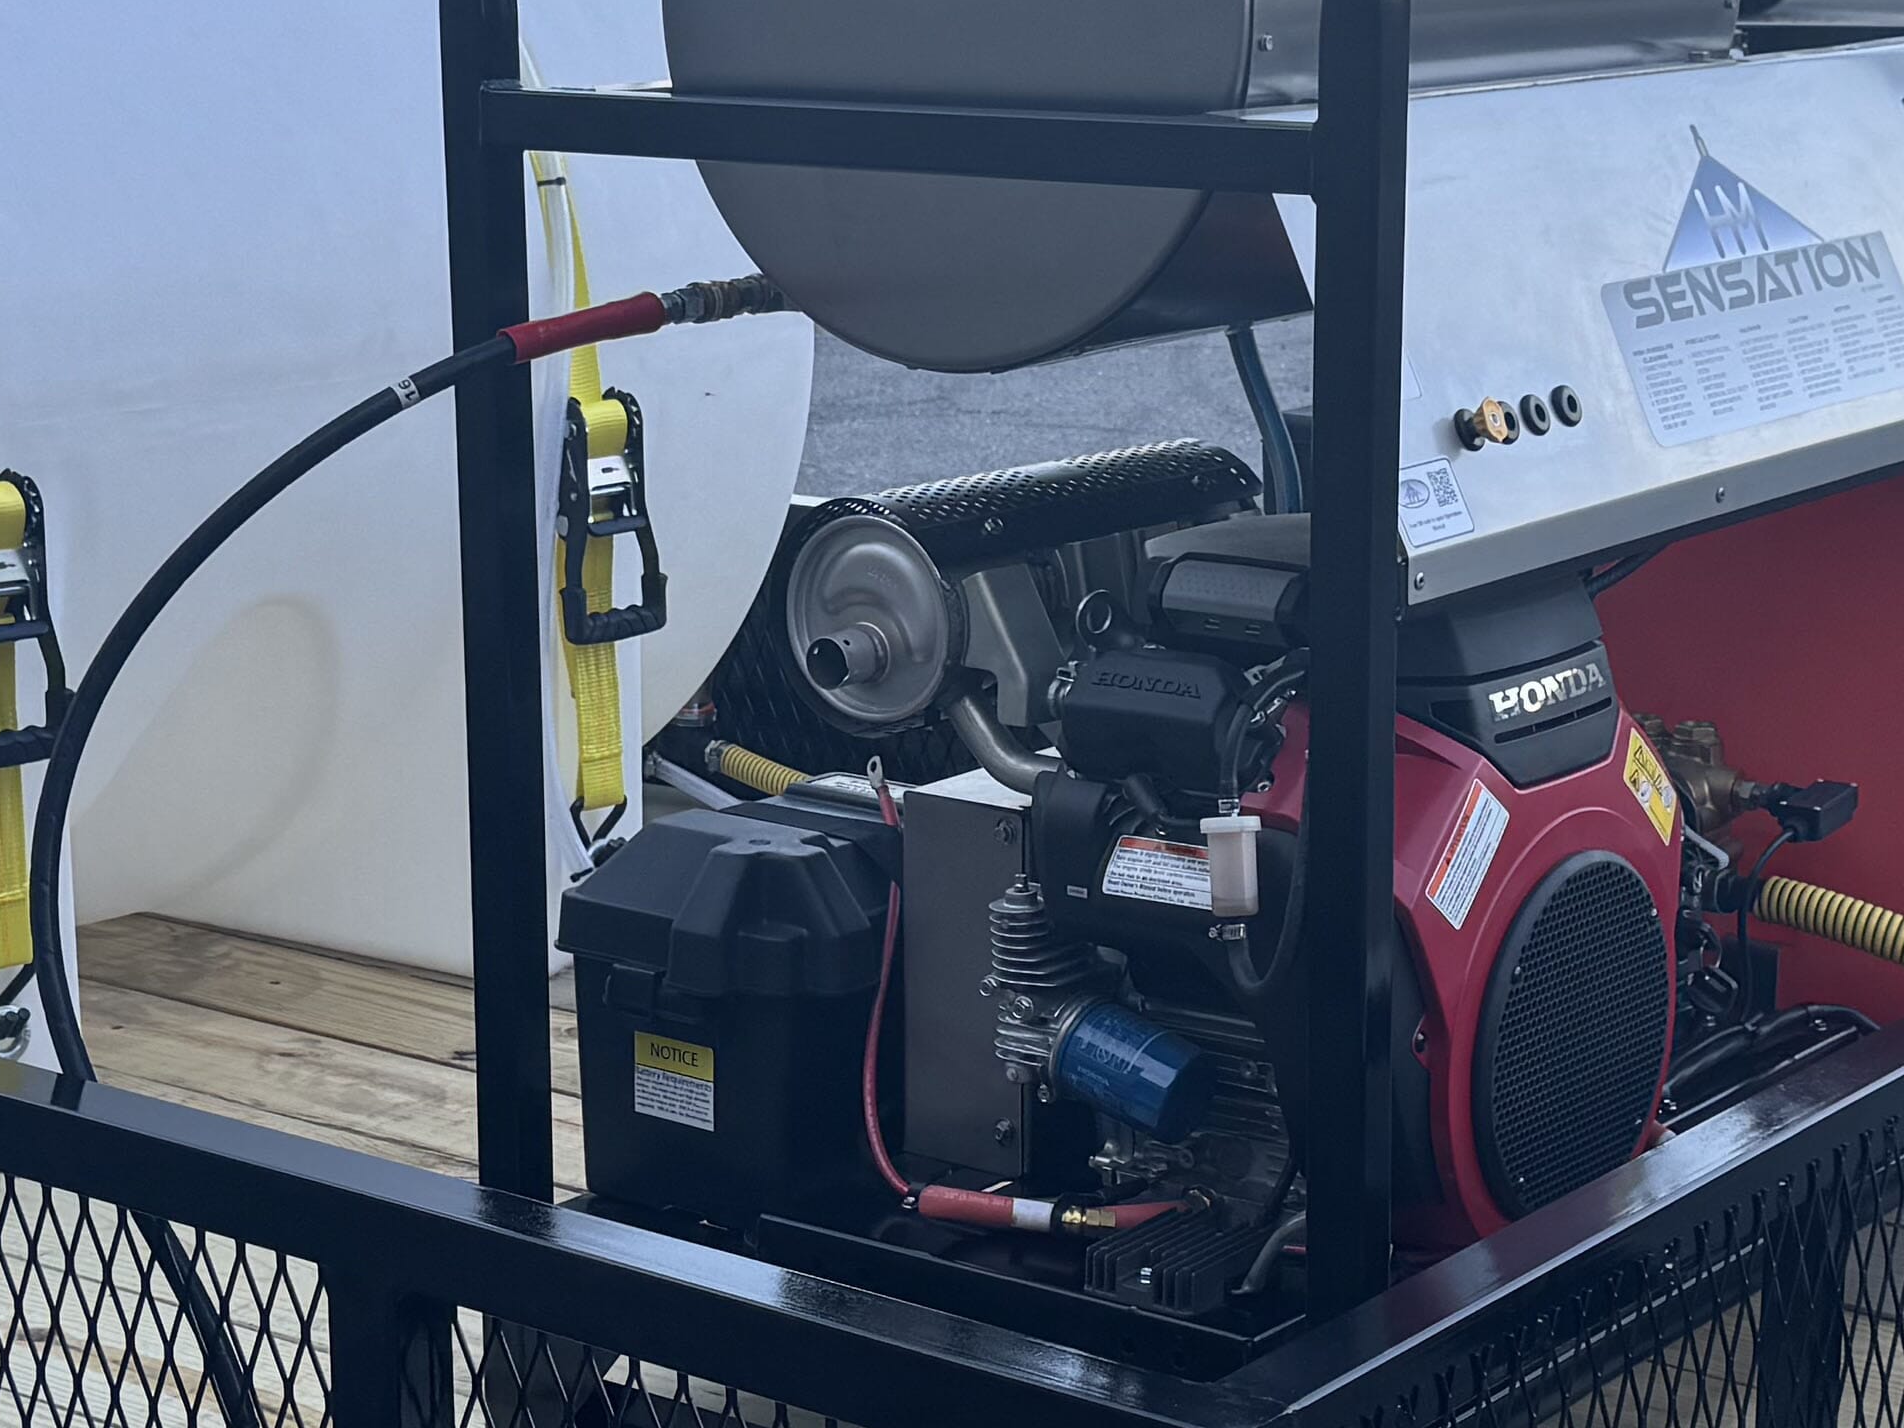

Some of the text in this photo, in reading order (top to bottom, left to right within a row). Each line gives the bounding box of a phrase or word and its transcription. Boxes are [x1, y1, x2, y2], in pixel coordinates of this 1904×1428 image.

[1623, 235, 1881, 329] SENSATION
[1091, 671, 1201, 700] HONDA
[1489, 663, 1607, 722] HONDA
[650, 1042, 699, 1067] NOTICE
